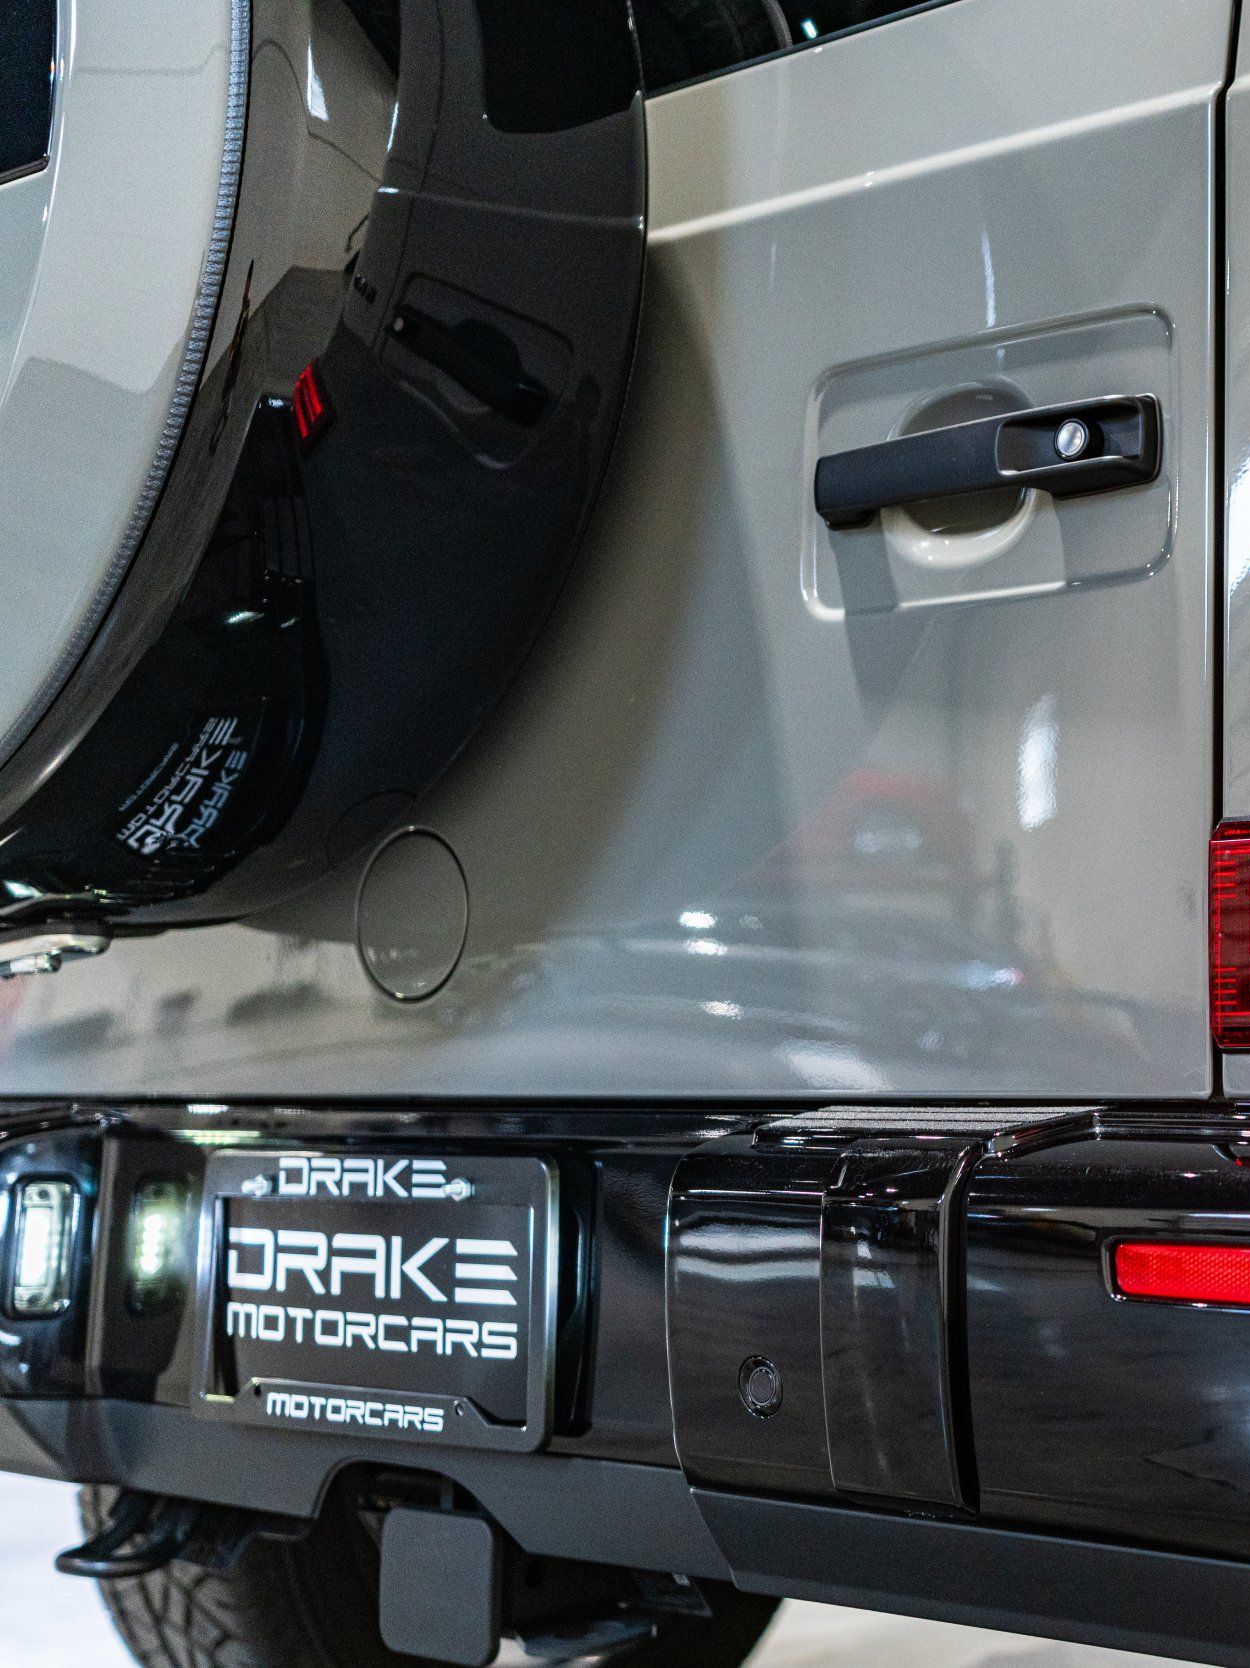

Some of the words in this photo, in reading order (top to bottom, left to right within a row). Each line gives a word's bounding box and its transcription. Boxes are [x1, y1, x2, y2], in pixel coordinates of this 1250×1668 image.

[278, 1157, 448, 1198] DRAKE
[227, 1227, 518, 1306] DRAKE
[227, 1301, 518, 1360] MOTORCARS
[266, 1392, 444, 1432] MOTORCARS
